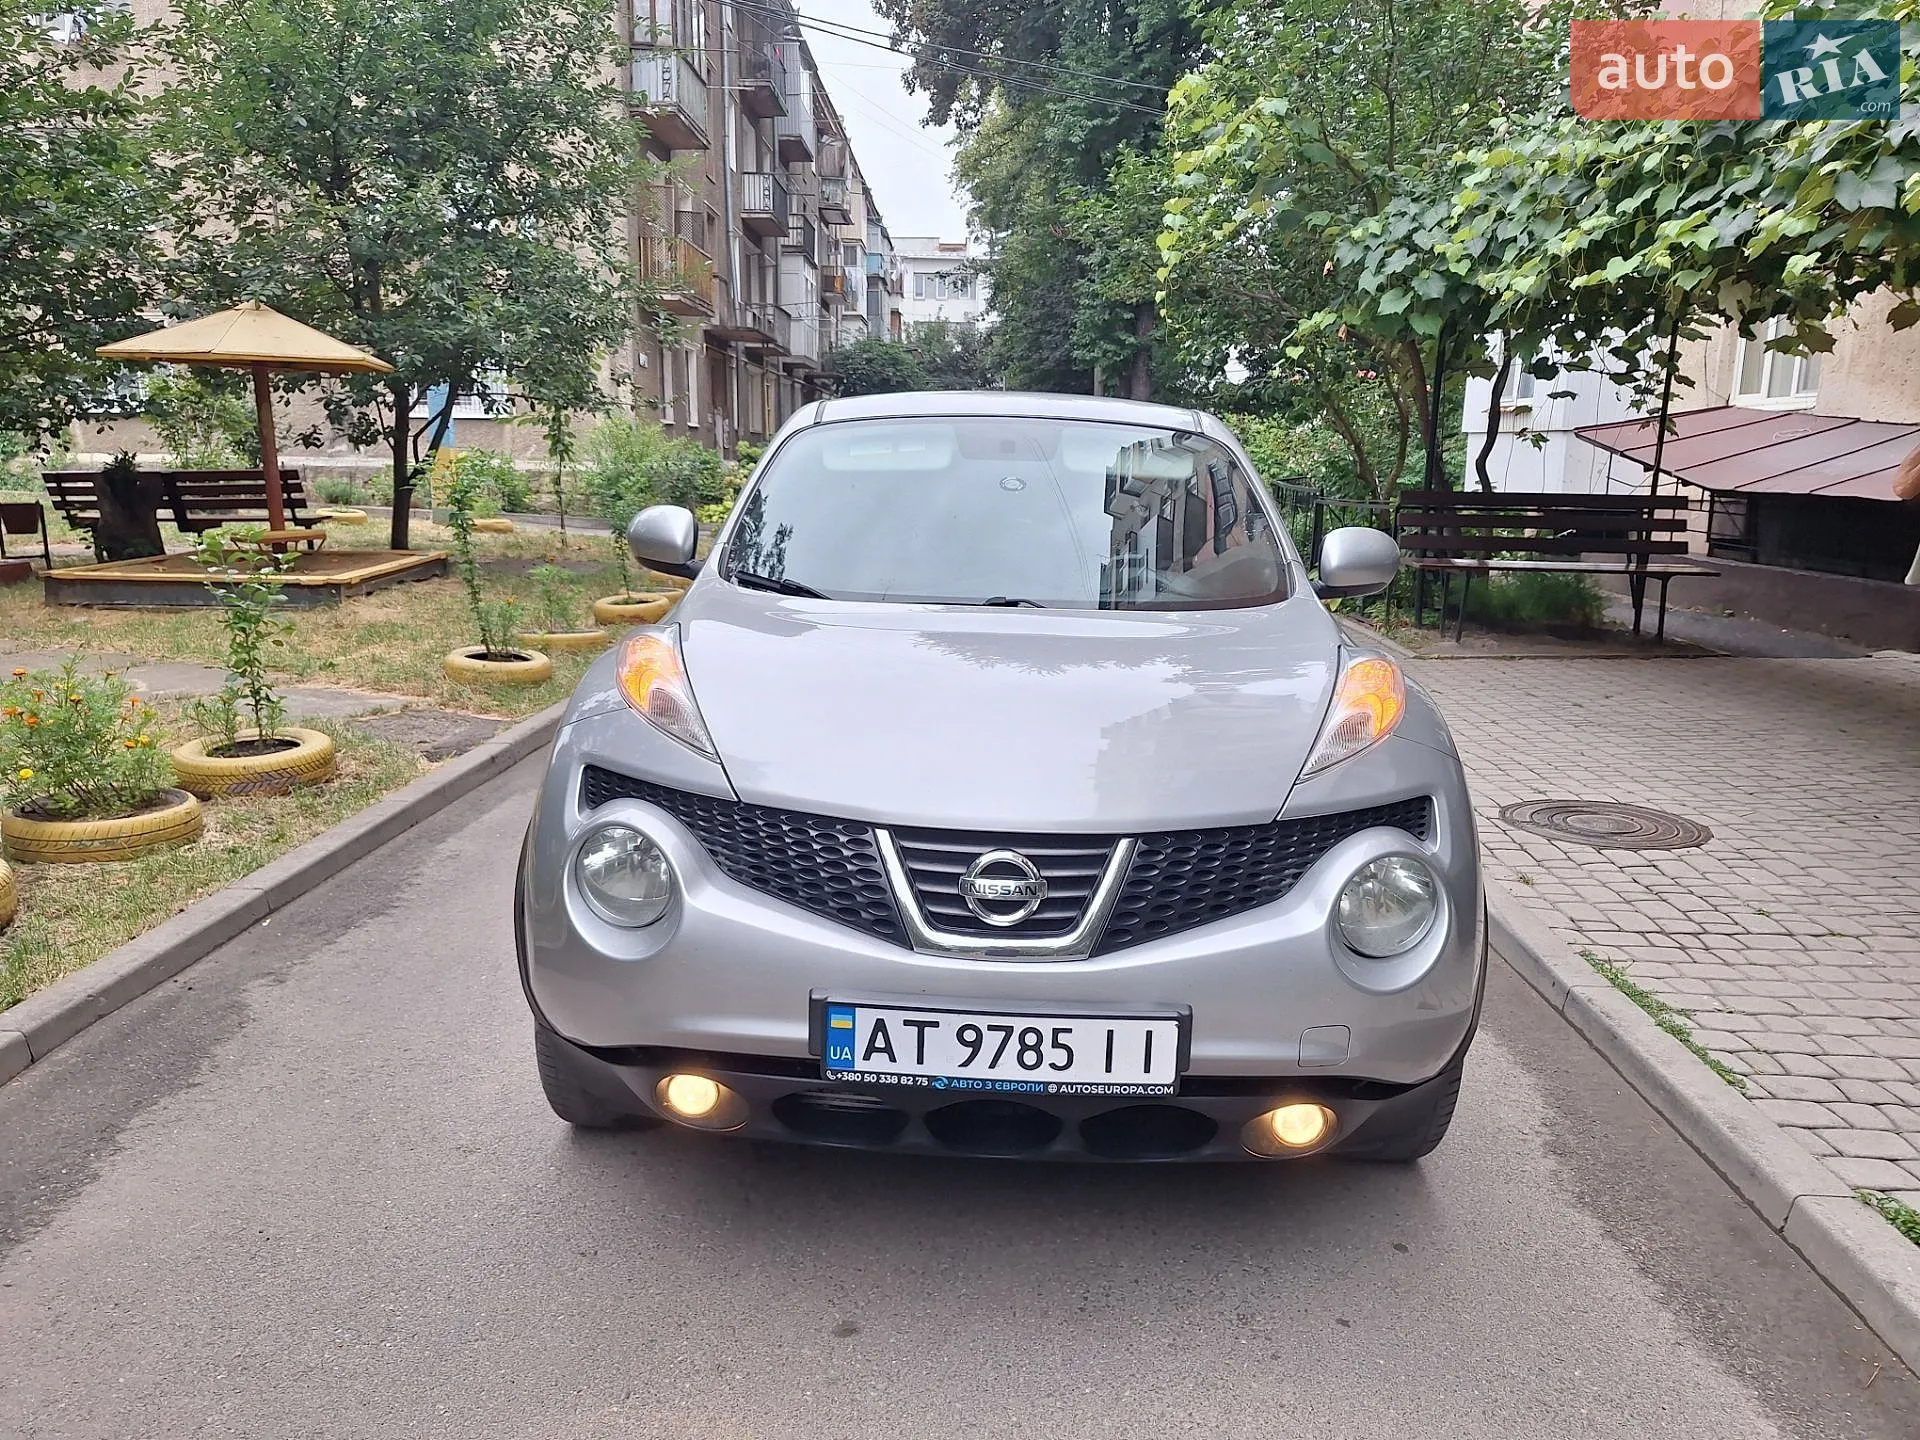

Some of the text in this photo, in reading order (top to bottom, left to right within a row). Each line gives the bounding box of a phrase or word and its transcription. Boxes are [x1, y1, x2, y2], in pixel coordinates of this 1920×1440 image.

[969, 882, 1037, 896] NISSAN
[862, 1017, 940, 1065] AT
[955, 1023, 1074, 1071] 9785
[830, 1046, 852, 1061] UA
[836, 1072, 929, 1086] +380 50 338 82 75
[950, 1079, 982, 1089] АВТО
[995, 1082, 1044, 1093] ЄВРОПИ
[1059, 1084, 1174, 1095] AUTOSEUROPA.COM
